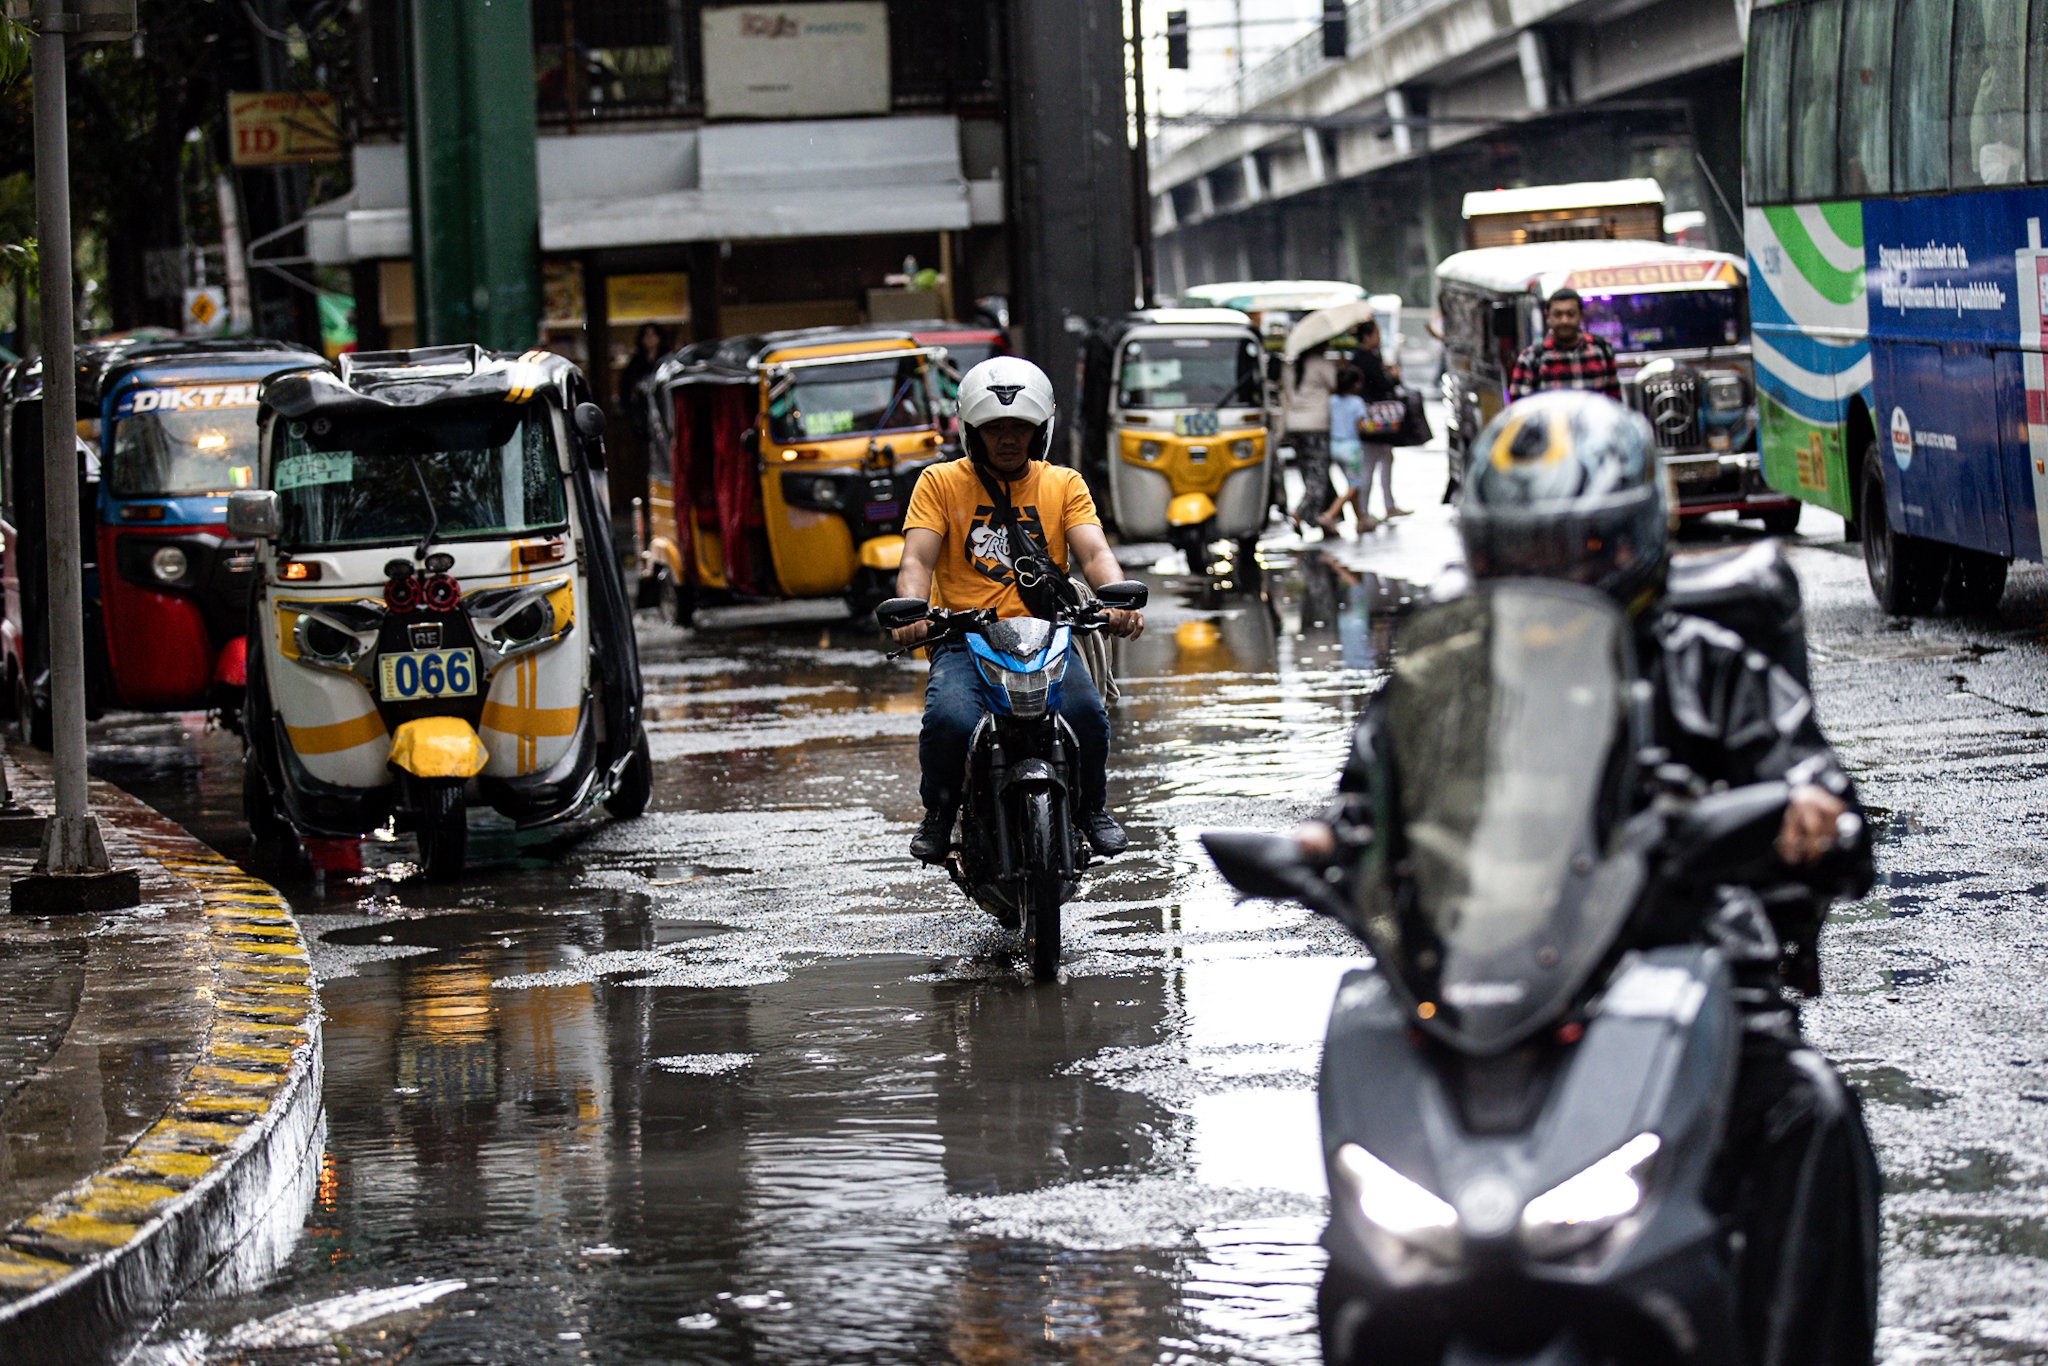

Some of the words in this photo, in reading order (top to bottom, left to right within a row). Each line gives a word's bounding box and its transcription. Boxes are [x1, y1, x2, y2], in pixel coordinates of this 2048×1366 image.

[237, 128, 279, 155] ID
[1571, 263, 1706, 290] Roselle
[414, 632, 438, 646] RE
[395, 652, 470, 697] 066
